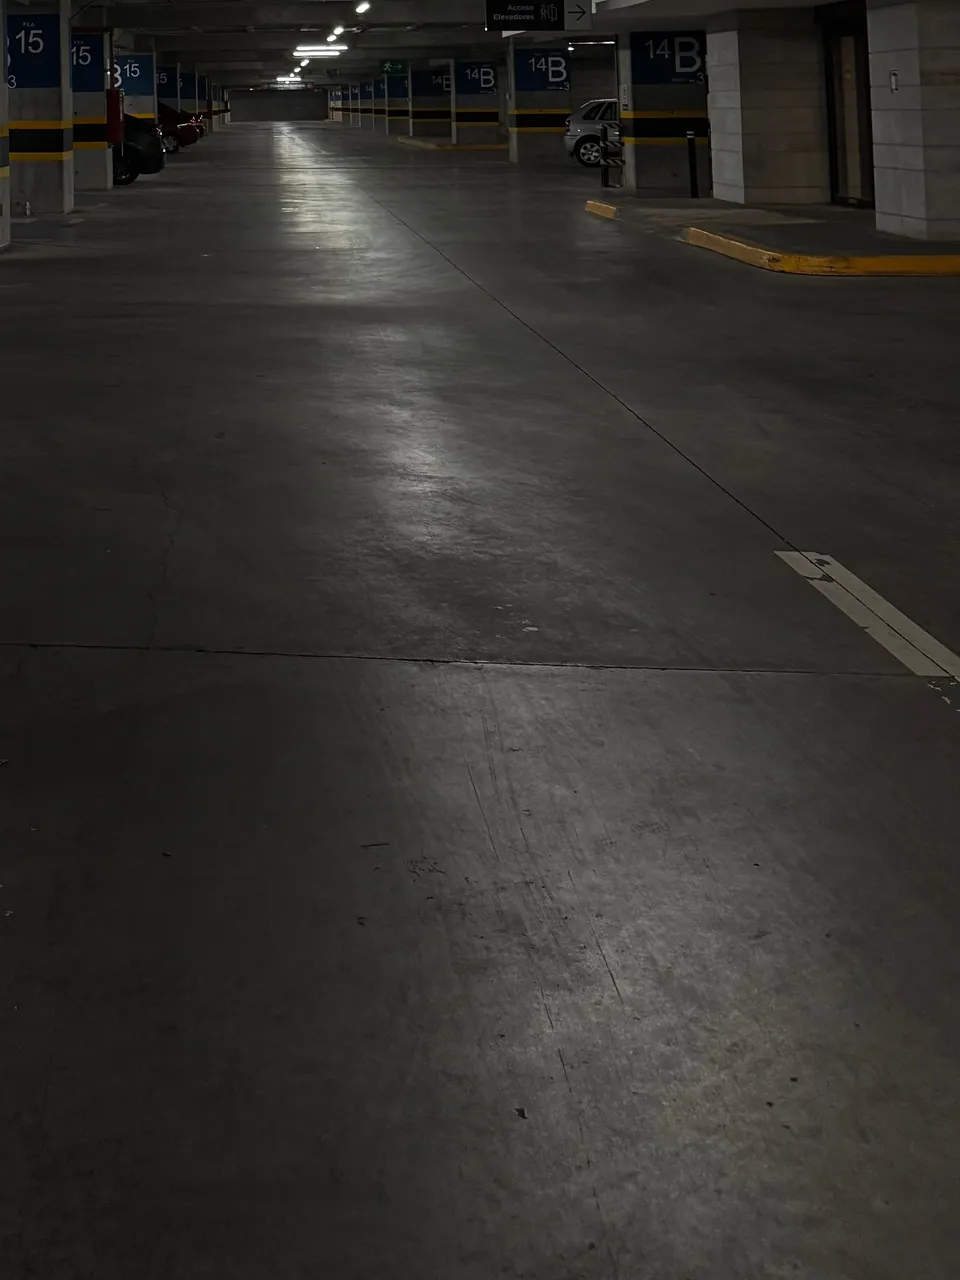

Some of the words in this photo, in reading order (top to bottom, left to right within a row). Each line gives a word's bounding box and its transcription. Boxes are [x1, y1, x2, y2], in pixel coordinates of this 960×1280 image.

[15, 29, 45, 54] 15
[70, 46, 92, 66] 15
[644, 38, 672, 59] 14
[674, 37, 702, 73] B
[123, 63, 140, 78] 15
[464, 68, 480, 80] 14
[480, 68, 496, 88] B
[528, 57, 548, 72] 14
[548, 57, 568, 82] B
